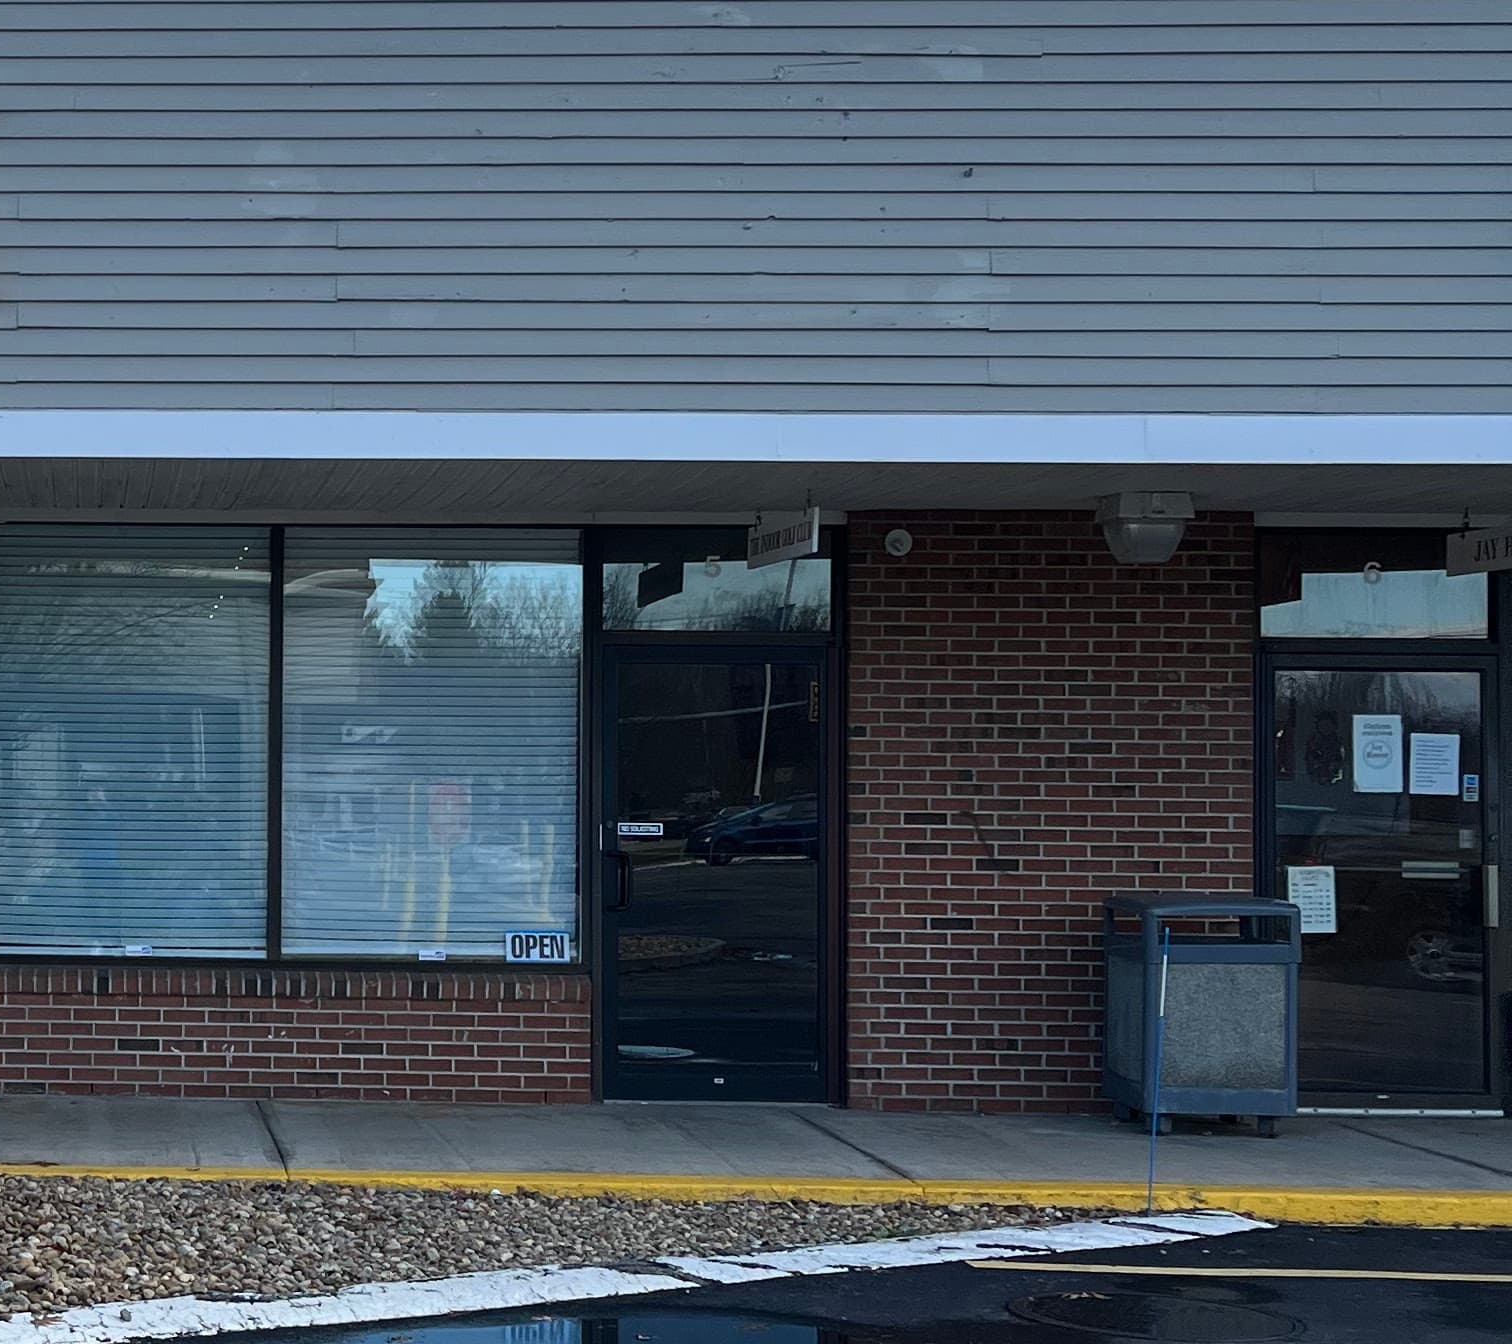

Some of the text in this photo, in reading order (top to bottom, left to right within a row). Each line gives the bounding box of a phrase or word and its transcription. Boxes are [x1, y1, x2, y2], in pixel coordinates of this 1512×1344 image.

[1473, 537, 1498, 562] JAY
[703, 555, 722, 578] 5
[1363, 561, 1382, 585] 6
[510, 934, 565, 959] OPEN
